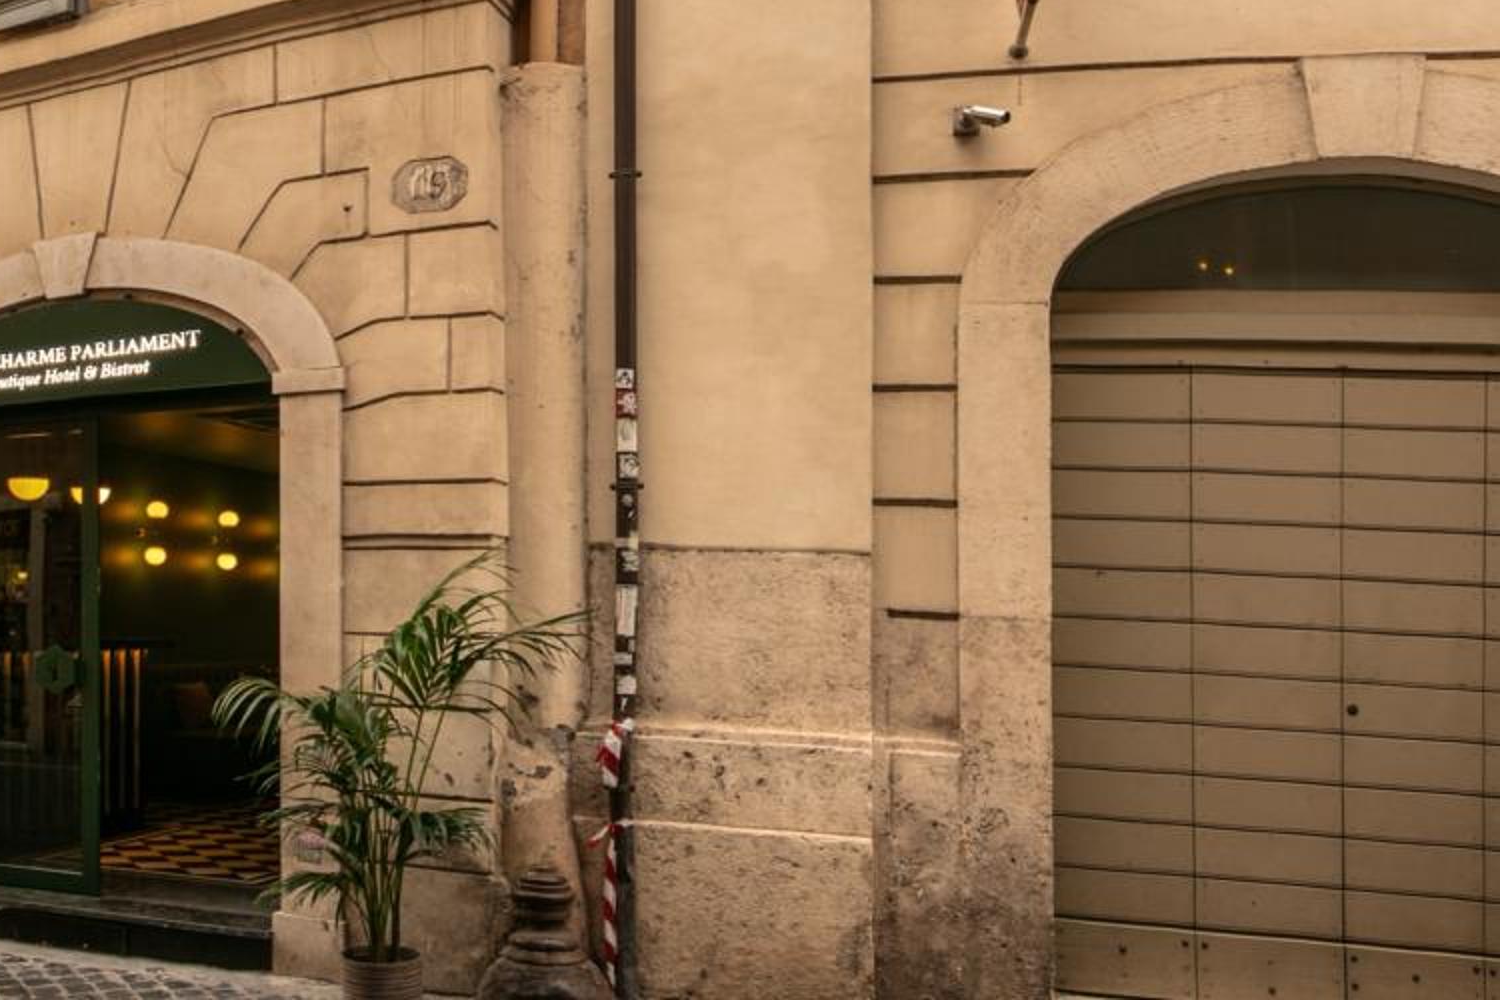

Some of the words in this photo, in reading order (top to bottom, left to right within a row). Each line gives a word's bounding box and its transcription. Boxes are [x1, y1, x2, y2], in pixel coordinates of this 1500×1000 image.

[70, 329, 201, 361] PARLIAMENT
[43, 365, 81, 385] Hotel
[83, 364, 99, 381] &
[100, 359, 151, 379] Bistrot
